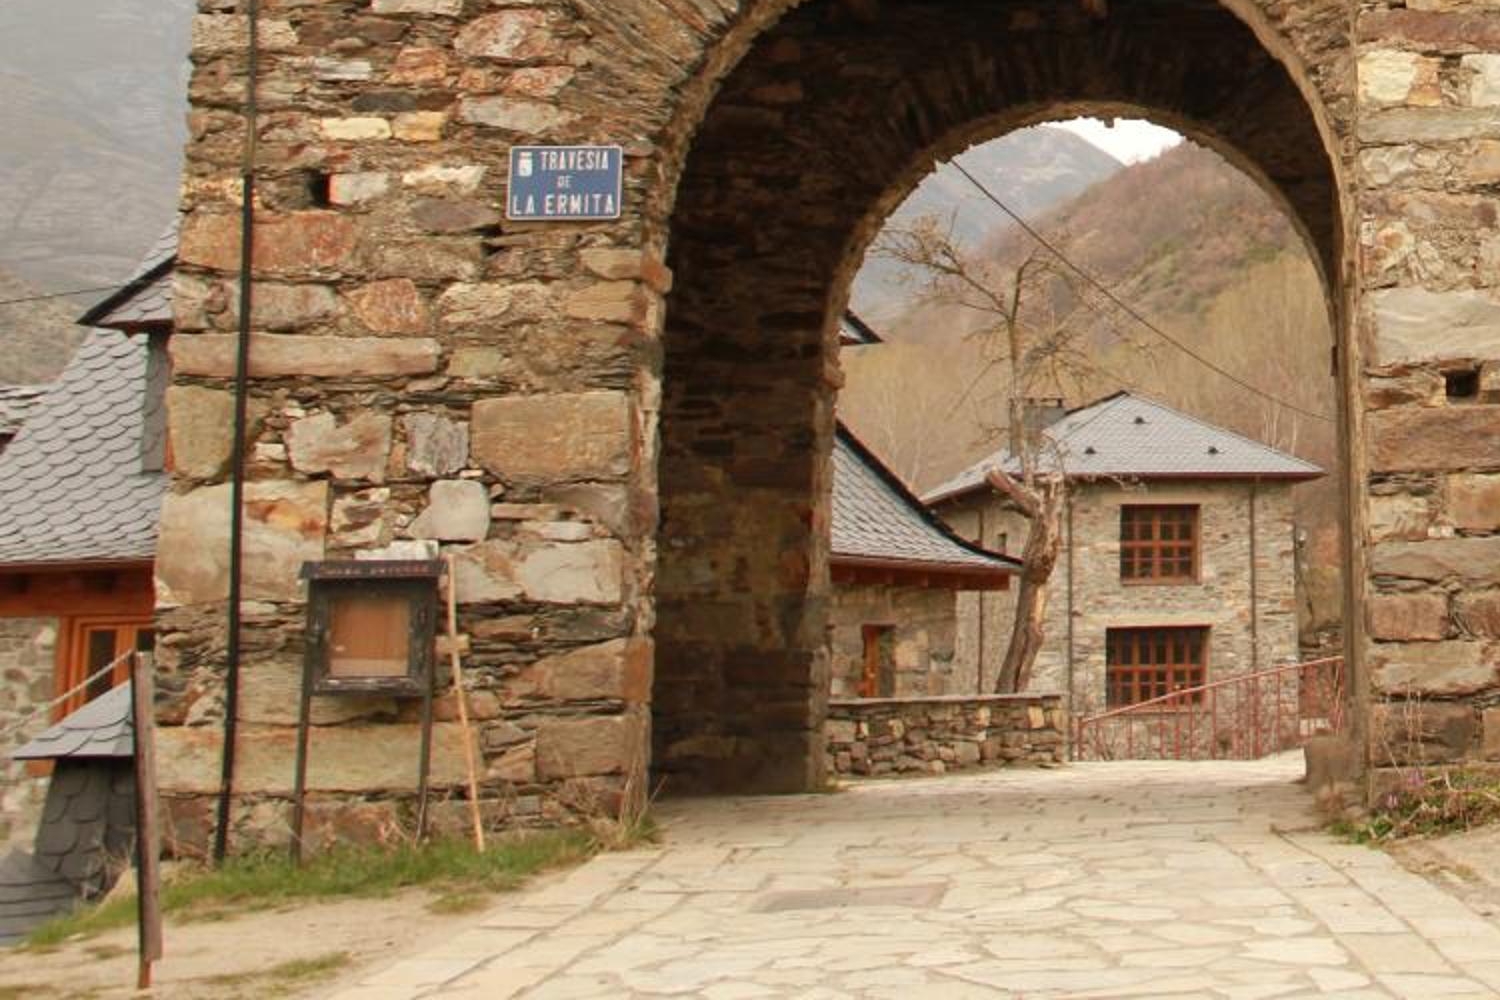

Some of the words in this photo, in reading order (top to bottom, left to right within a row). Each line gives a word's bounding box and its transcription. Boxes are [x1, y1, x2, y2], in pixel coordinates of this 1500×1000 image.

[541, 151, 608, 170] TRAVESIA
[557, 176, 571, 188] DE
[512, 195, 535, 215] LA
[545, 194, 615, 215] ERMITA
